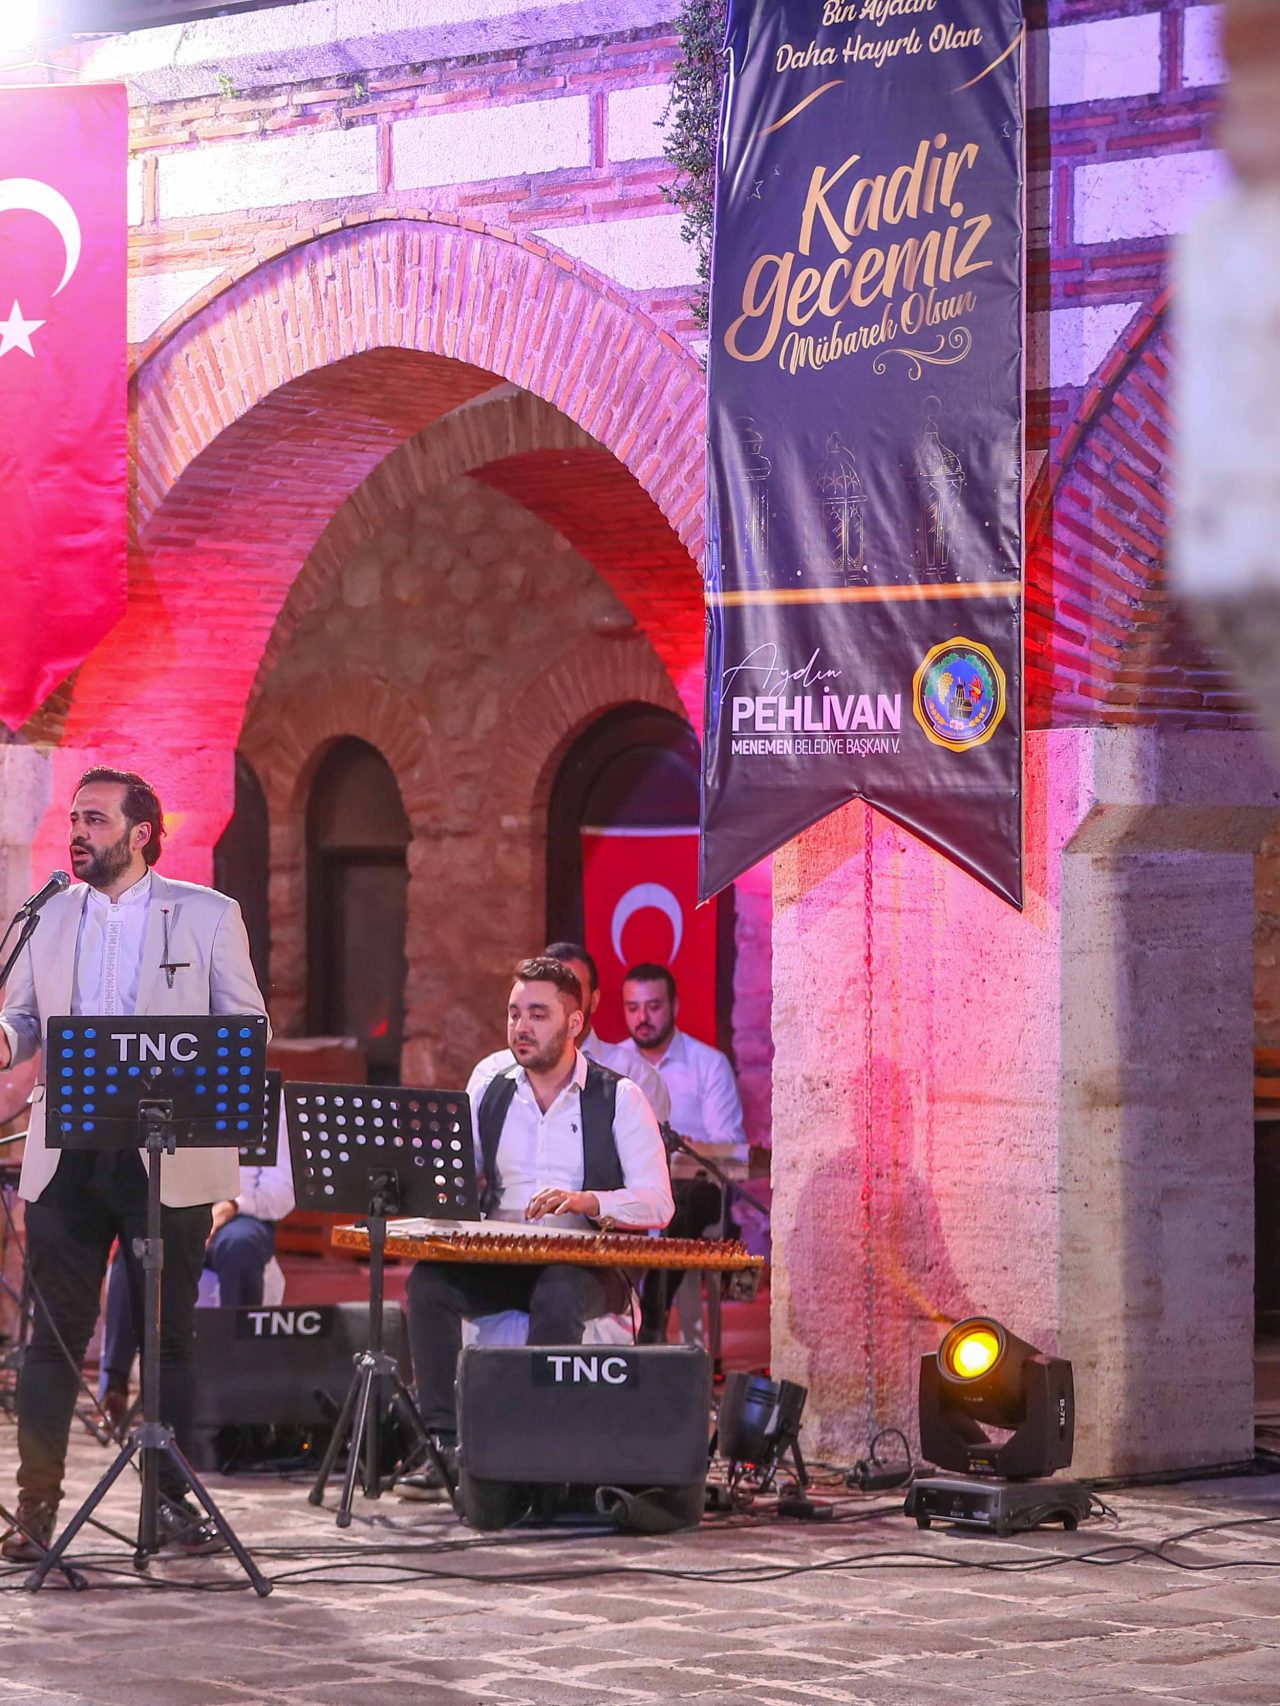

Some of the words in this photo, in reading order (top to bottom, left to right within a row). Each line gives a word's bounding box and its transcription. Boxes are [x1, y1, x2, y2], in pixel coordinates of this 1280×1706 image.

[822, 0, 856, 26] Bin
[860, 0, 935, 28] Aydan
[776, 43, 837, 73] Daha
[843, 28, 922, 68] Hayırlı
[928, 23, 983, 53] Olan
[798, 132, 979, 255] Kadir
[724, 201, 993, 362] gecemiz
[778, 303, 897, 375] Mübarek
[900, 286, 976, 334] Olsun
[719, 642, 842, 705] Aydın
[731, 685, 901, 731] PEHLİVAN
[731, 738, 792, 755] MENEMEN
[794, 735, 844, 755] BELEDİYE
[846, 740, 889, 758] BAŞKAN
[890, 740, 901, 754] V.
[111, 1033, 199, 1062] TNC
[247, 1311, 321, 1336] TNC
[546, 1355, 628, 1385] TNC
